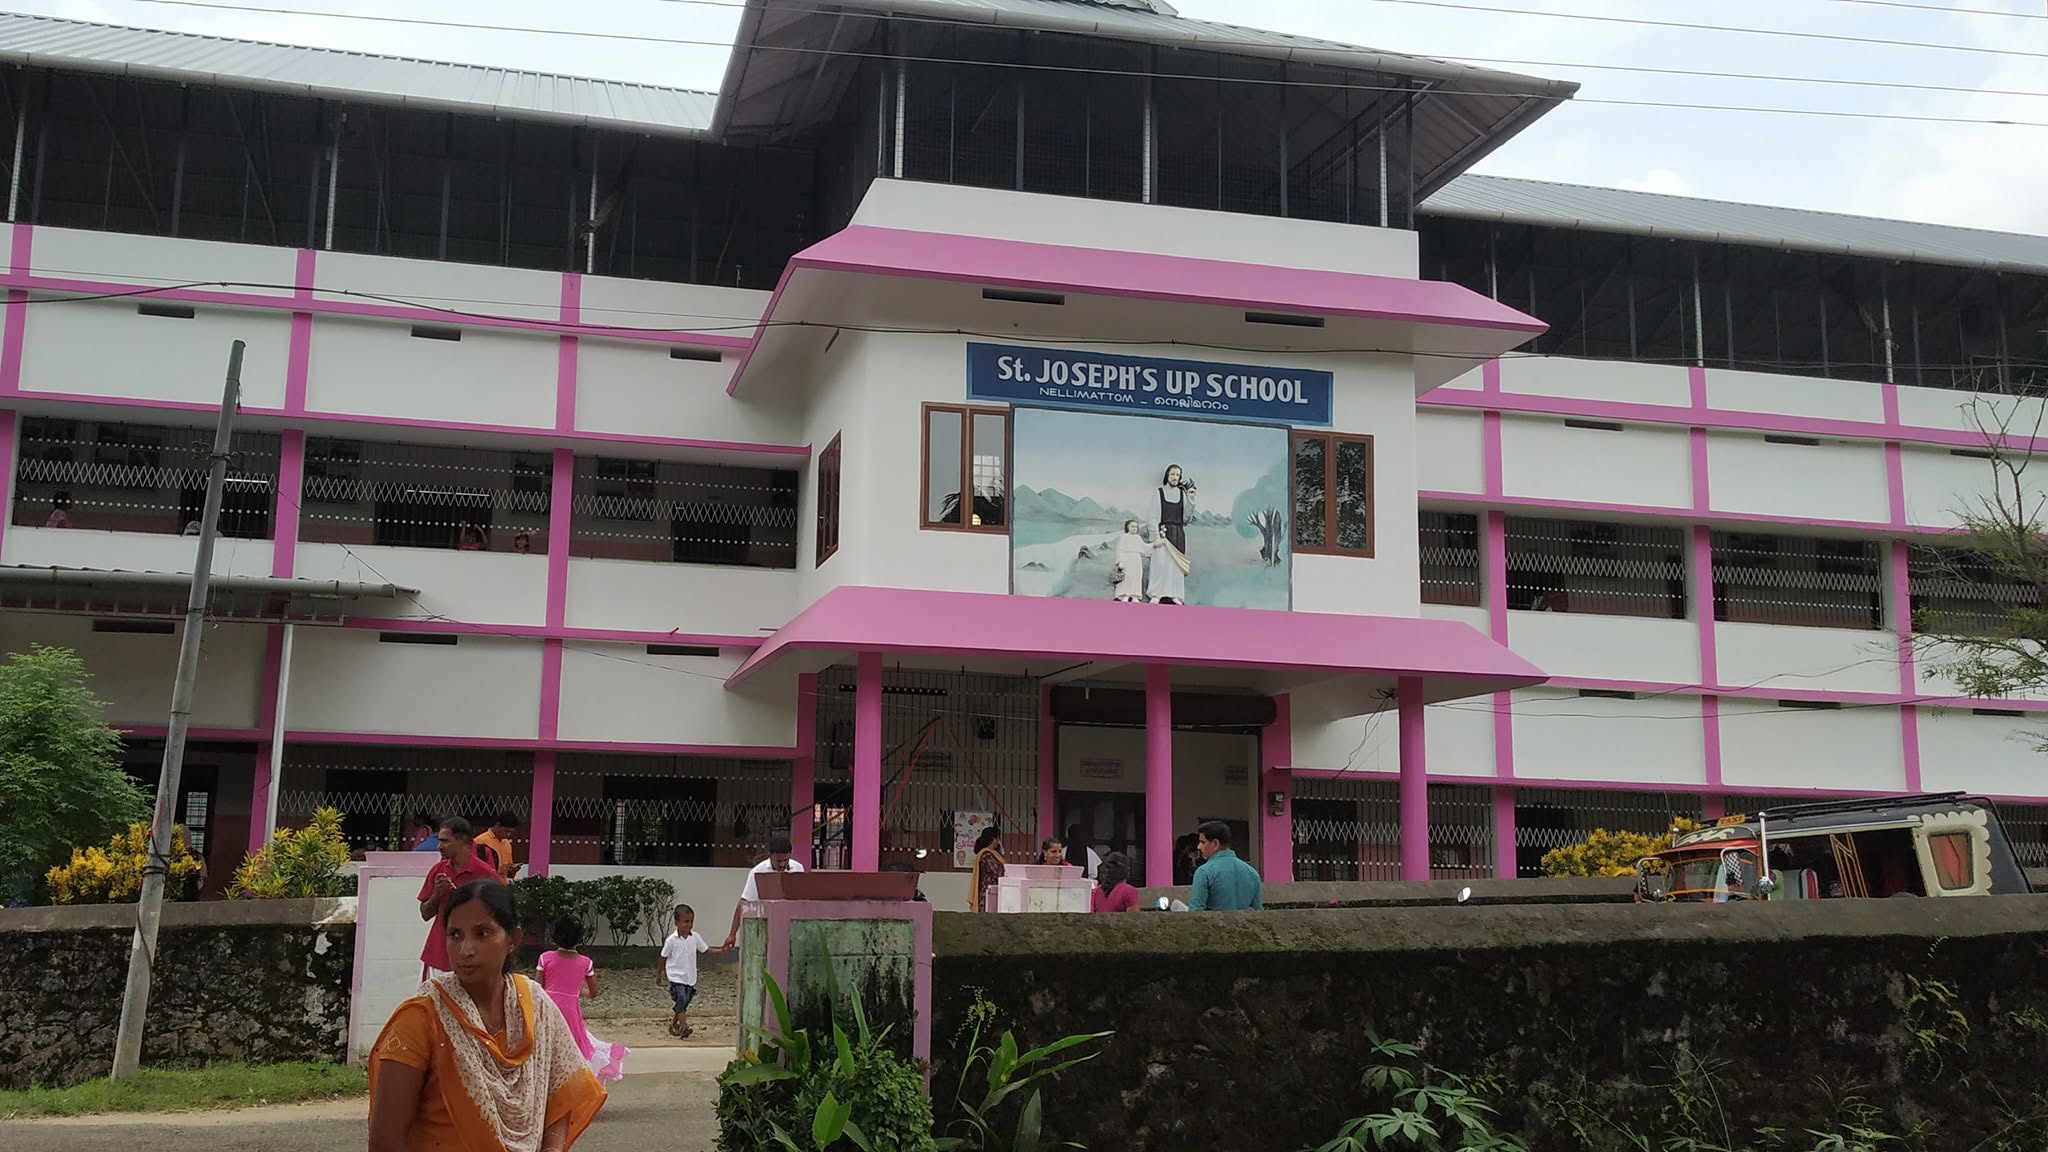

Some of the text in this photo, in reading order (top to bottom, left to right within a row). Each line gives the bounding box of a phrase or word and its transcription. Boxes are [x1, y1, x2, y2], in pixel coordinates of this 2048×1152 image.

[997, 355, 1309, 404] St. JOSEPH'S UP SCHOOL
[1039, 387, 1134, 403] NELLIMATTOM
[1719, 815, 1744, 825] TAXI
